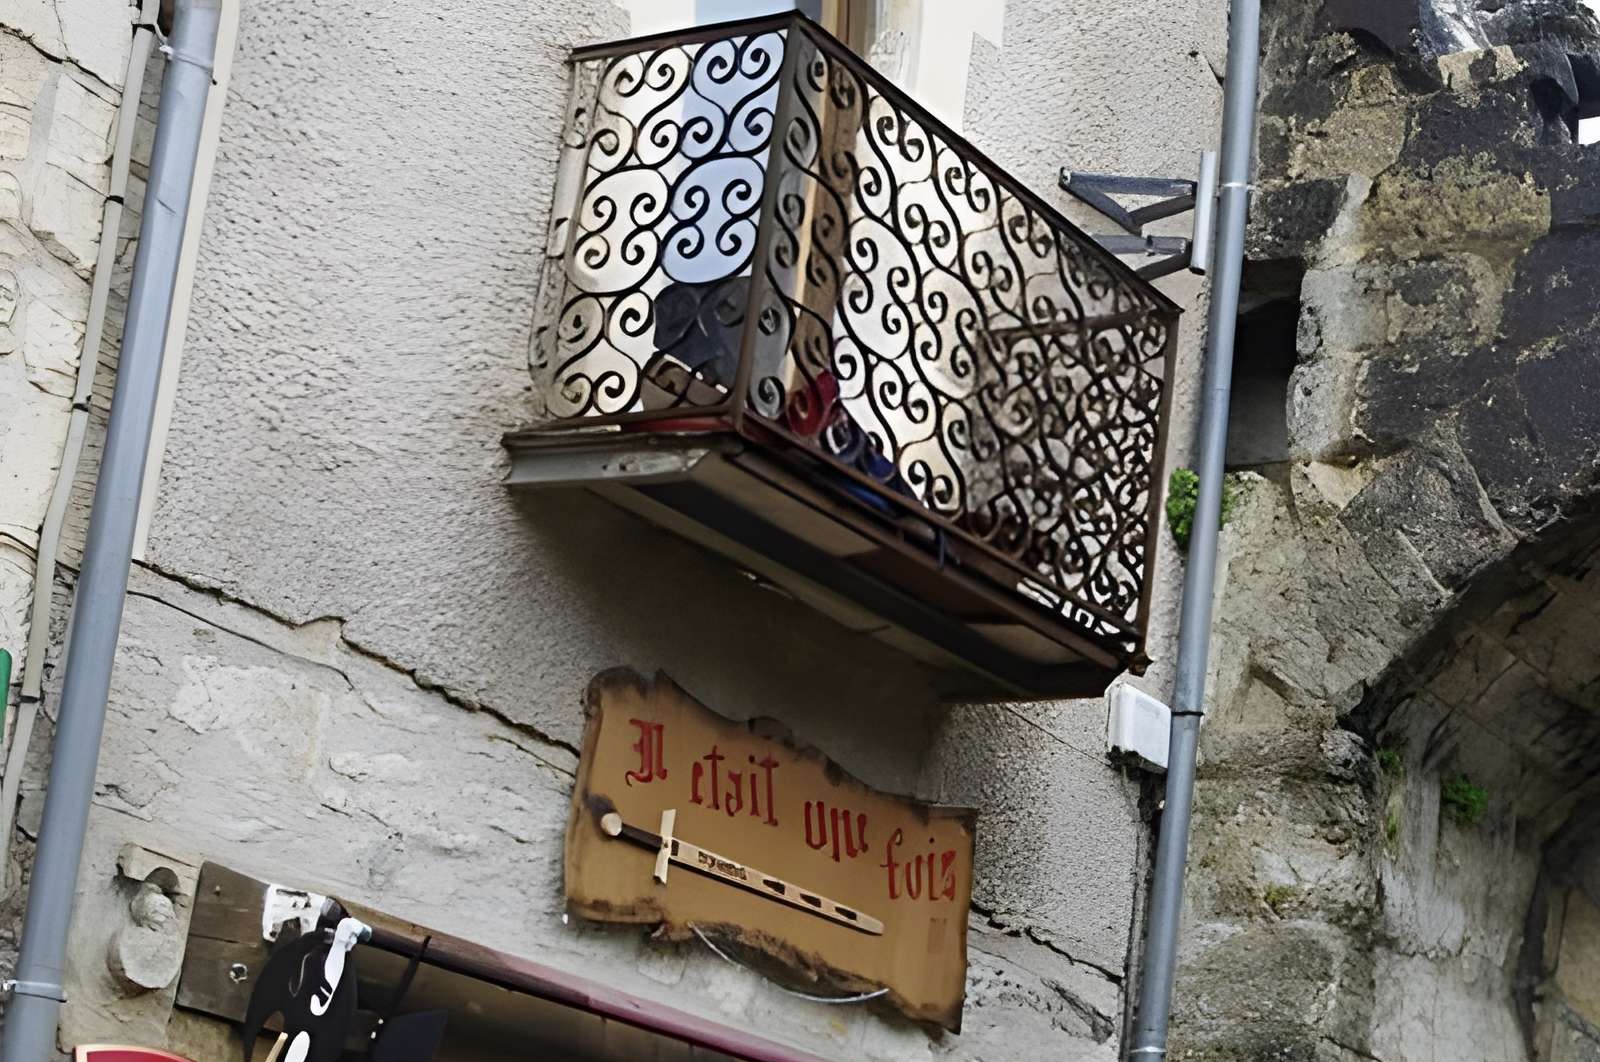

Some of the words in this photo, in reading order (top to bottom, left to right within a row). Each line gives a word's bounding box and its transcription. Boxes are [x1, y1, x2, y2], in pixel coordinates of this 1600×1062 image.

[625, 718, 668, 787] Il
[805, 801, 869, 863] une
[879, 827, 957, 901] fois
